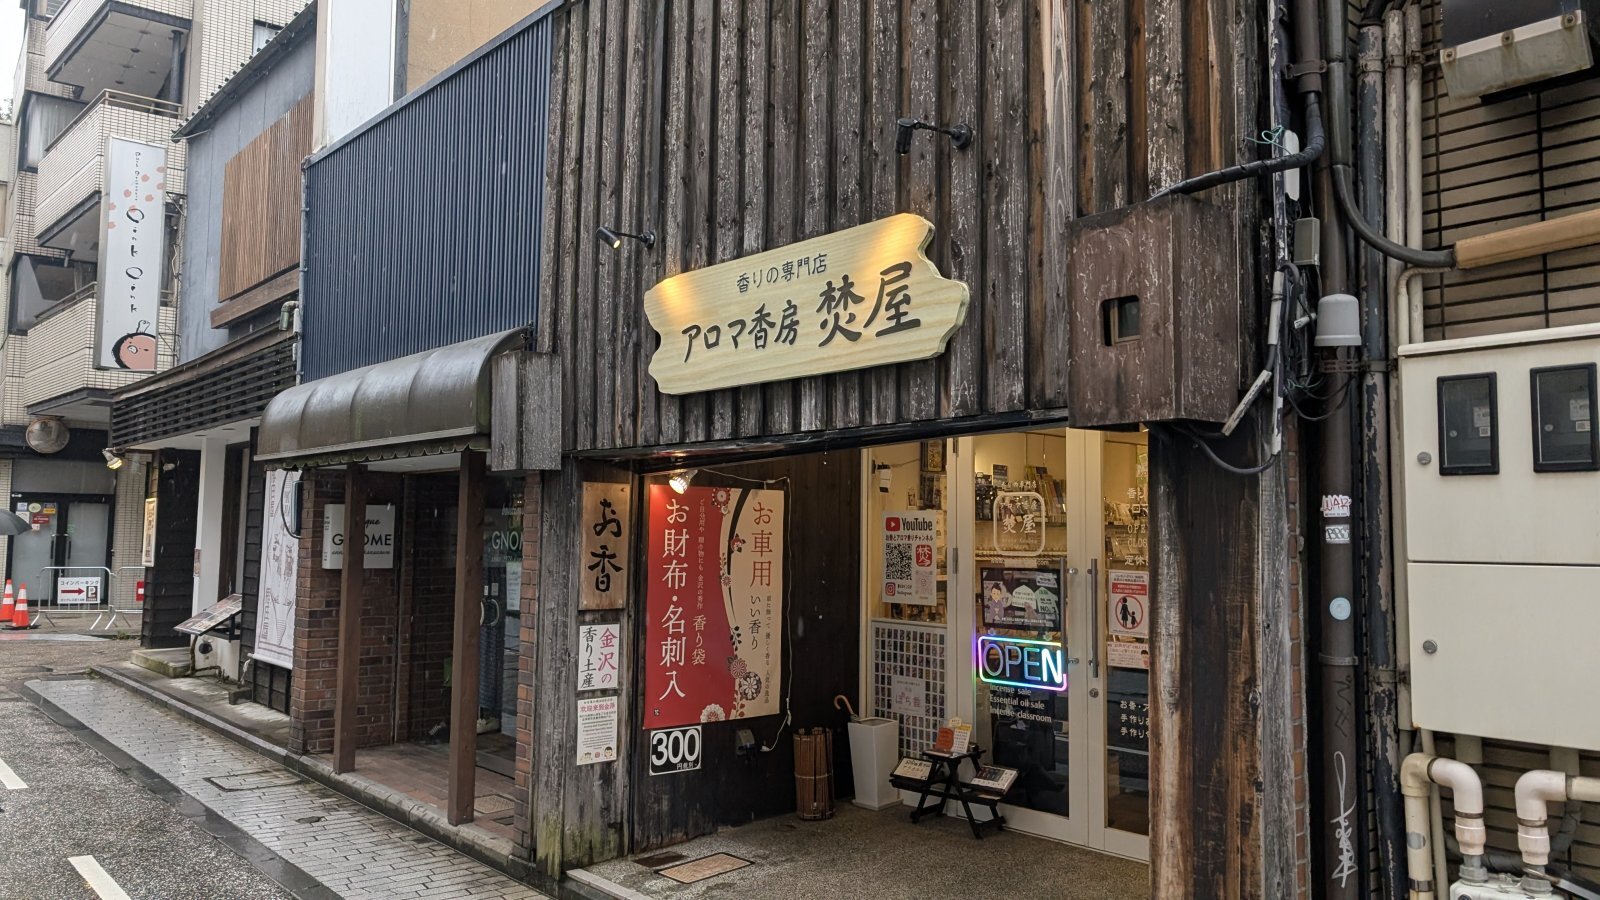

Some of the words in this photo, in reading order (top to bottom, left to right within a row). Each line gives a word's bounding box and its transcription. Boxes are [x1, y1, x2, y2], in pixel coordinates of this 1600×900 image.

[736, 253, 828, 294] 香りの専門店
[681, 299, 800, 363] アロマ香房
[815, 261, 921, 348] 焚屋
[901, 516, 933, 531] YouTube
[1003, 514, 1037, 534] 焚屋
[1127, 525, 1147, 534] OPE
[332, 533, 392, 546] GME
[491, 531, 523, 550] GNO
[588, 498, 624, 592] お香
[750, 502, 773, 588] お車用
[1127, 538, 1148, 548] CLOS
[1124, 555, 1149, 566] 定休
[659, 498, 690, 701] お財布・名刺入
[748, 595, 761, 650] いい香り
[691, 614, 706, 666] 香り袋
[580, 626, 598, 689] 香り土産
[598, 627, 619, 684] 金沢の
[983, 643, 1062, 684] OPEN
[990, 694, 1019, 706] Essential
[1020, 699, 1029, 707] oil
[1031, 701, 1045, 710] sale
[1017, 688, 1032, 696] sale
[1120, 700, 1149, 712] お香・ア
[1017, 710, 1052, 723] classroom
[651, 728, 700, 766] 300
